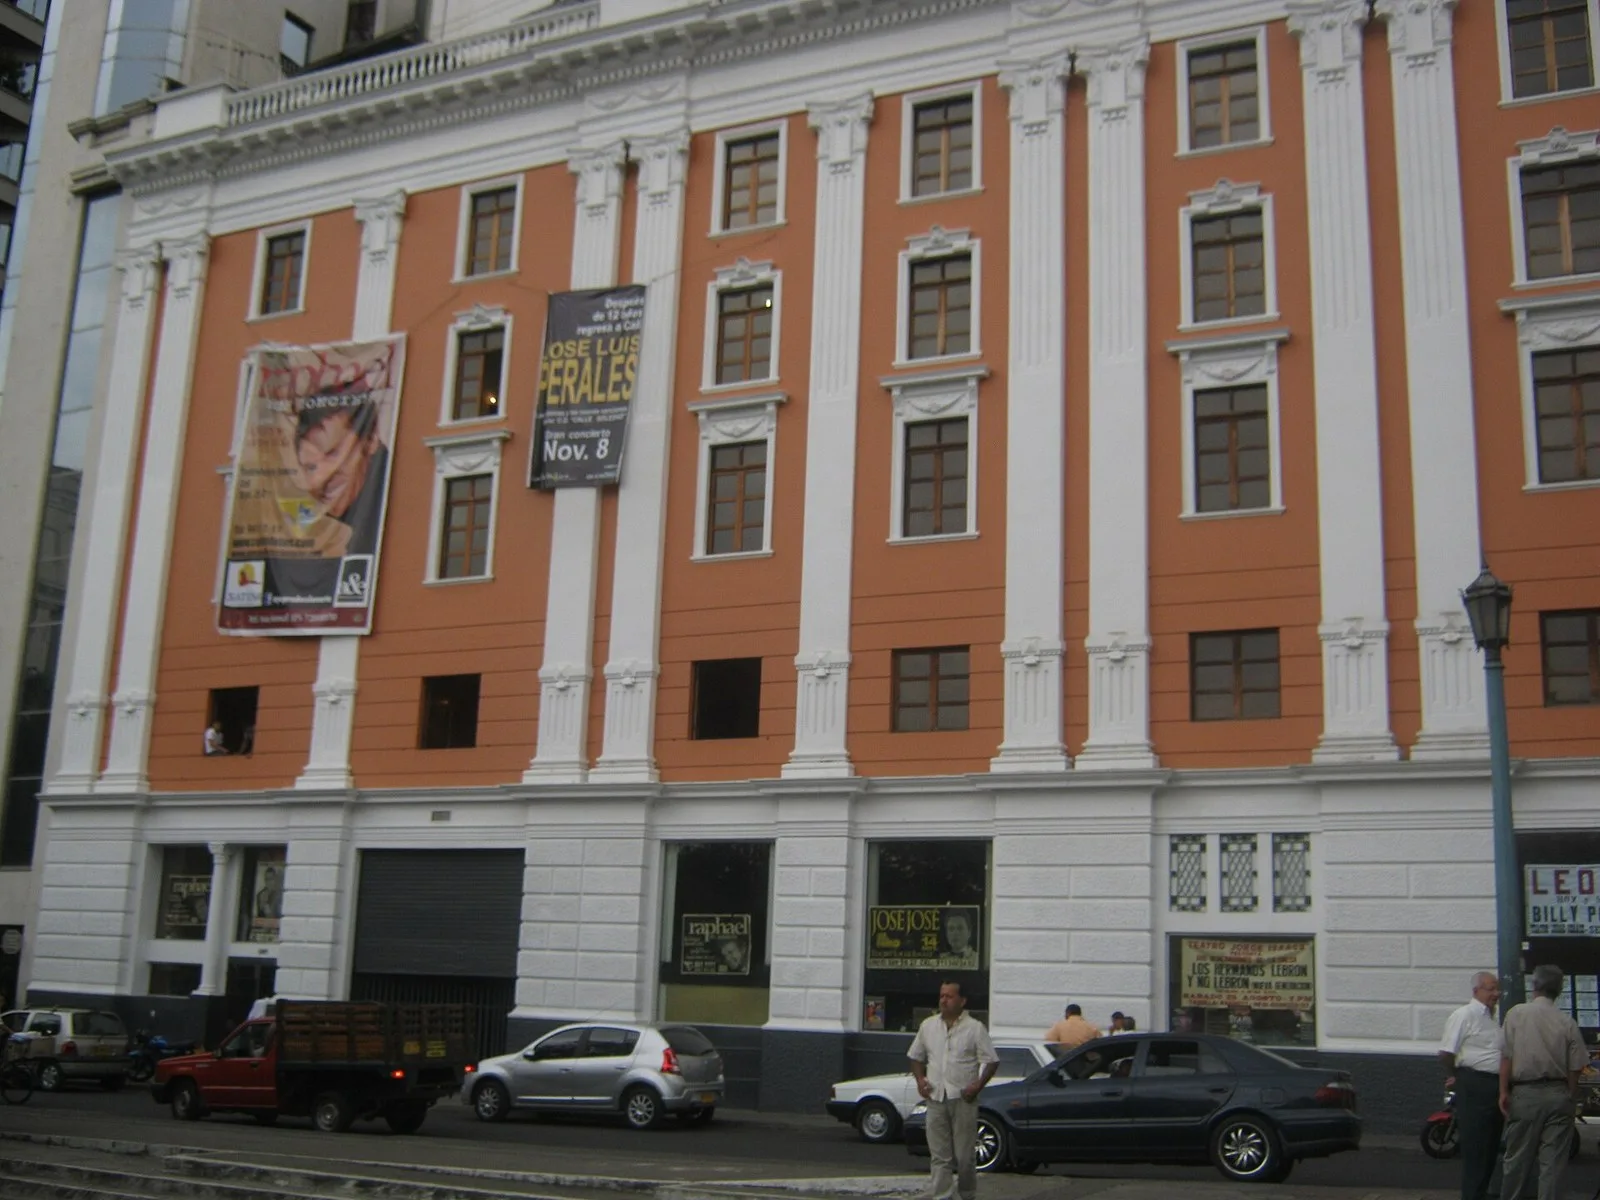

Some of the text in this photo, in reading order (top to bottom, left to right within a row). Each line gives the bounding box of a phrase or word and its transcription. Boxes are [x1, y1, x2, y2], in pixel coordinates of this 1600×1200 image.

[592, 310, 605, 322] de
[607, 309, 619, 321] 12
[576, 323, 613, 337] regresa
[623, 318, 640, 331] Cali
[596, 335, 640, 357] LUIS
[539, 354, 638, 405] PERALES
[568, 428, 611, 440] concierto
[543, 438, 610, 462] Nov. 8
[1531, 869, 1594, 895] LEO
[1532, 905, 1600, 923] BILLY P
[688, 915, 748, 942] raphael
[1187, 941, 1225, 950] TEATRO
[1231, 943, 1263, 952] JORGE
[1192, 962, 1308, 977] LOS HERMANOS LEBRON
[1187, 975, 1193, 988] Y
[1214, 976, 1249, 989] LEBRON
